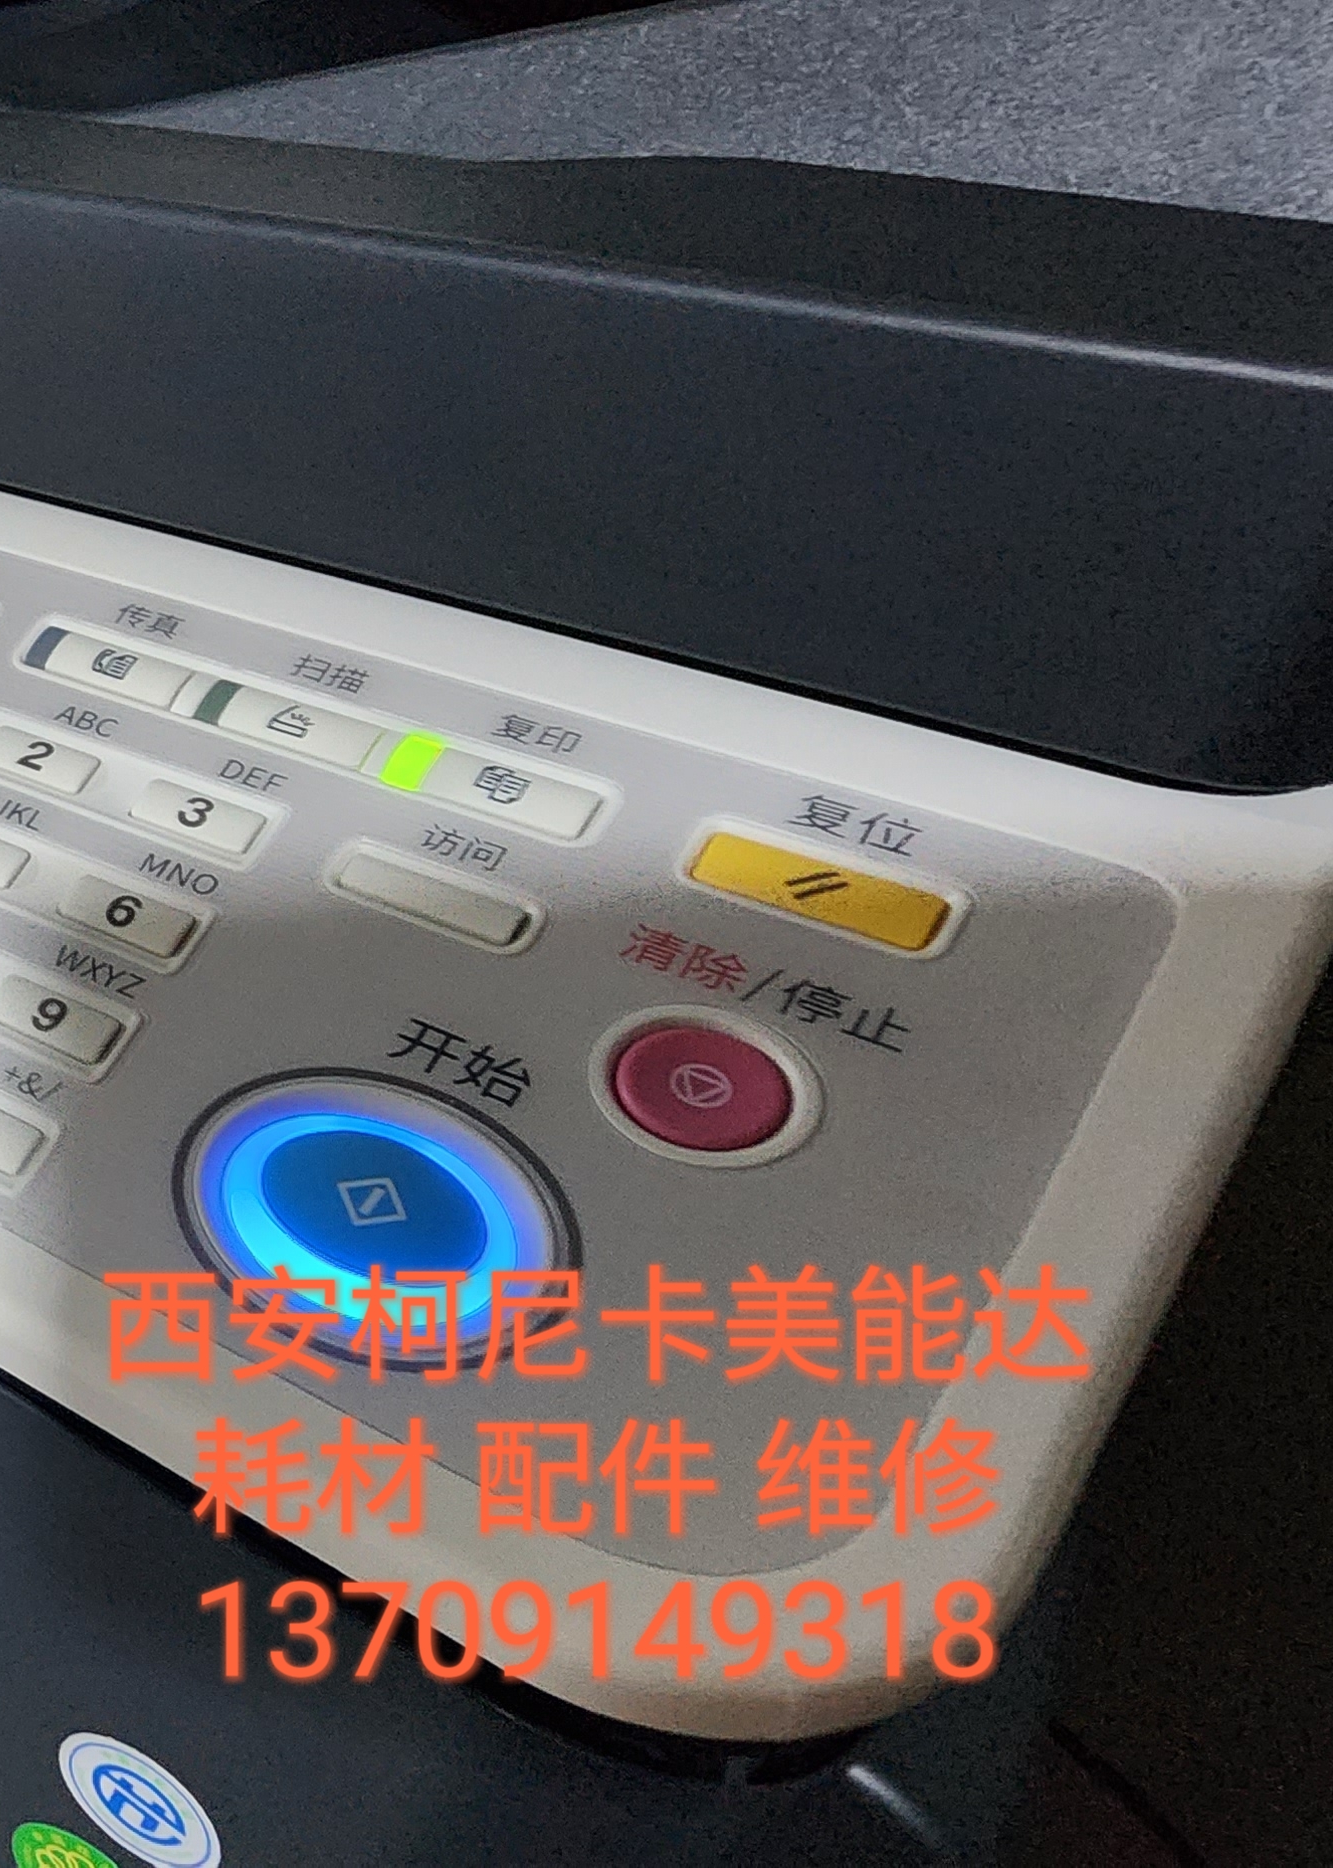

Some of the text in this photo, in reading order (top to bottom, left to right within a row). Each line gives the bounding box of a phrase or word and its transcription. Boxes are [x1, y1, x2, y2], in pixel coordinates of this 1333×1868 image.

[115, 603, 187, 639] 传真
[292, 653, 370, 694] 扫描
[54, 705, 119, 739] ABC
[492, 712, 583, 755] 复印
[16, 740, 56, 771] 2
[217, 757, 289, 796] DEF
[177, 798, 214, 828] 3
[786, 793, 926, 858] 复位
[421, 823, 510, 873] 访问
[139, 852, 220, 896] MNO
[105, 894, 145, 927] 6
[55, 943, 147, 999] WXYZ
[617, 923, 913, 1055] 清除/停止
[31, 998, 68, 1032] 9
[386, 1017, 537, 1110] 开始
